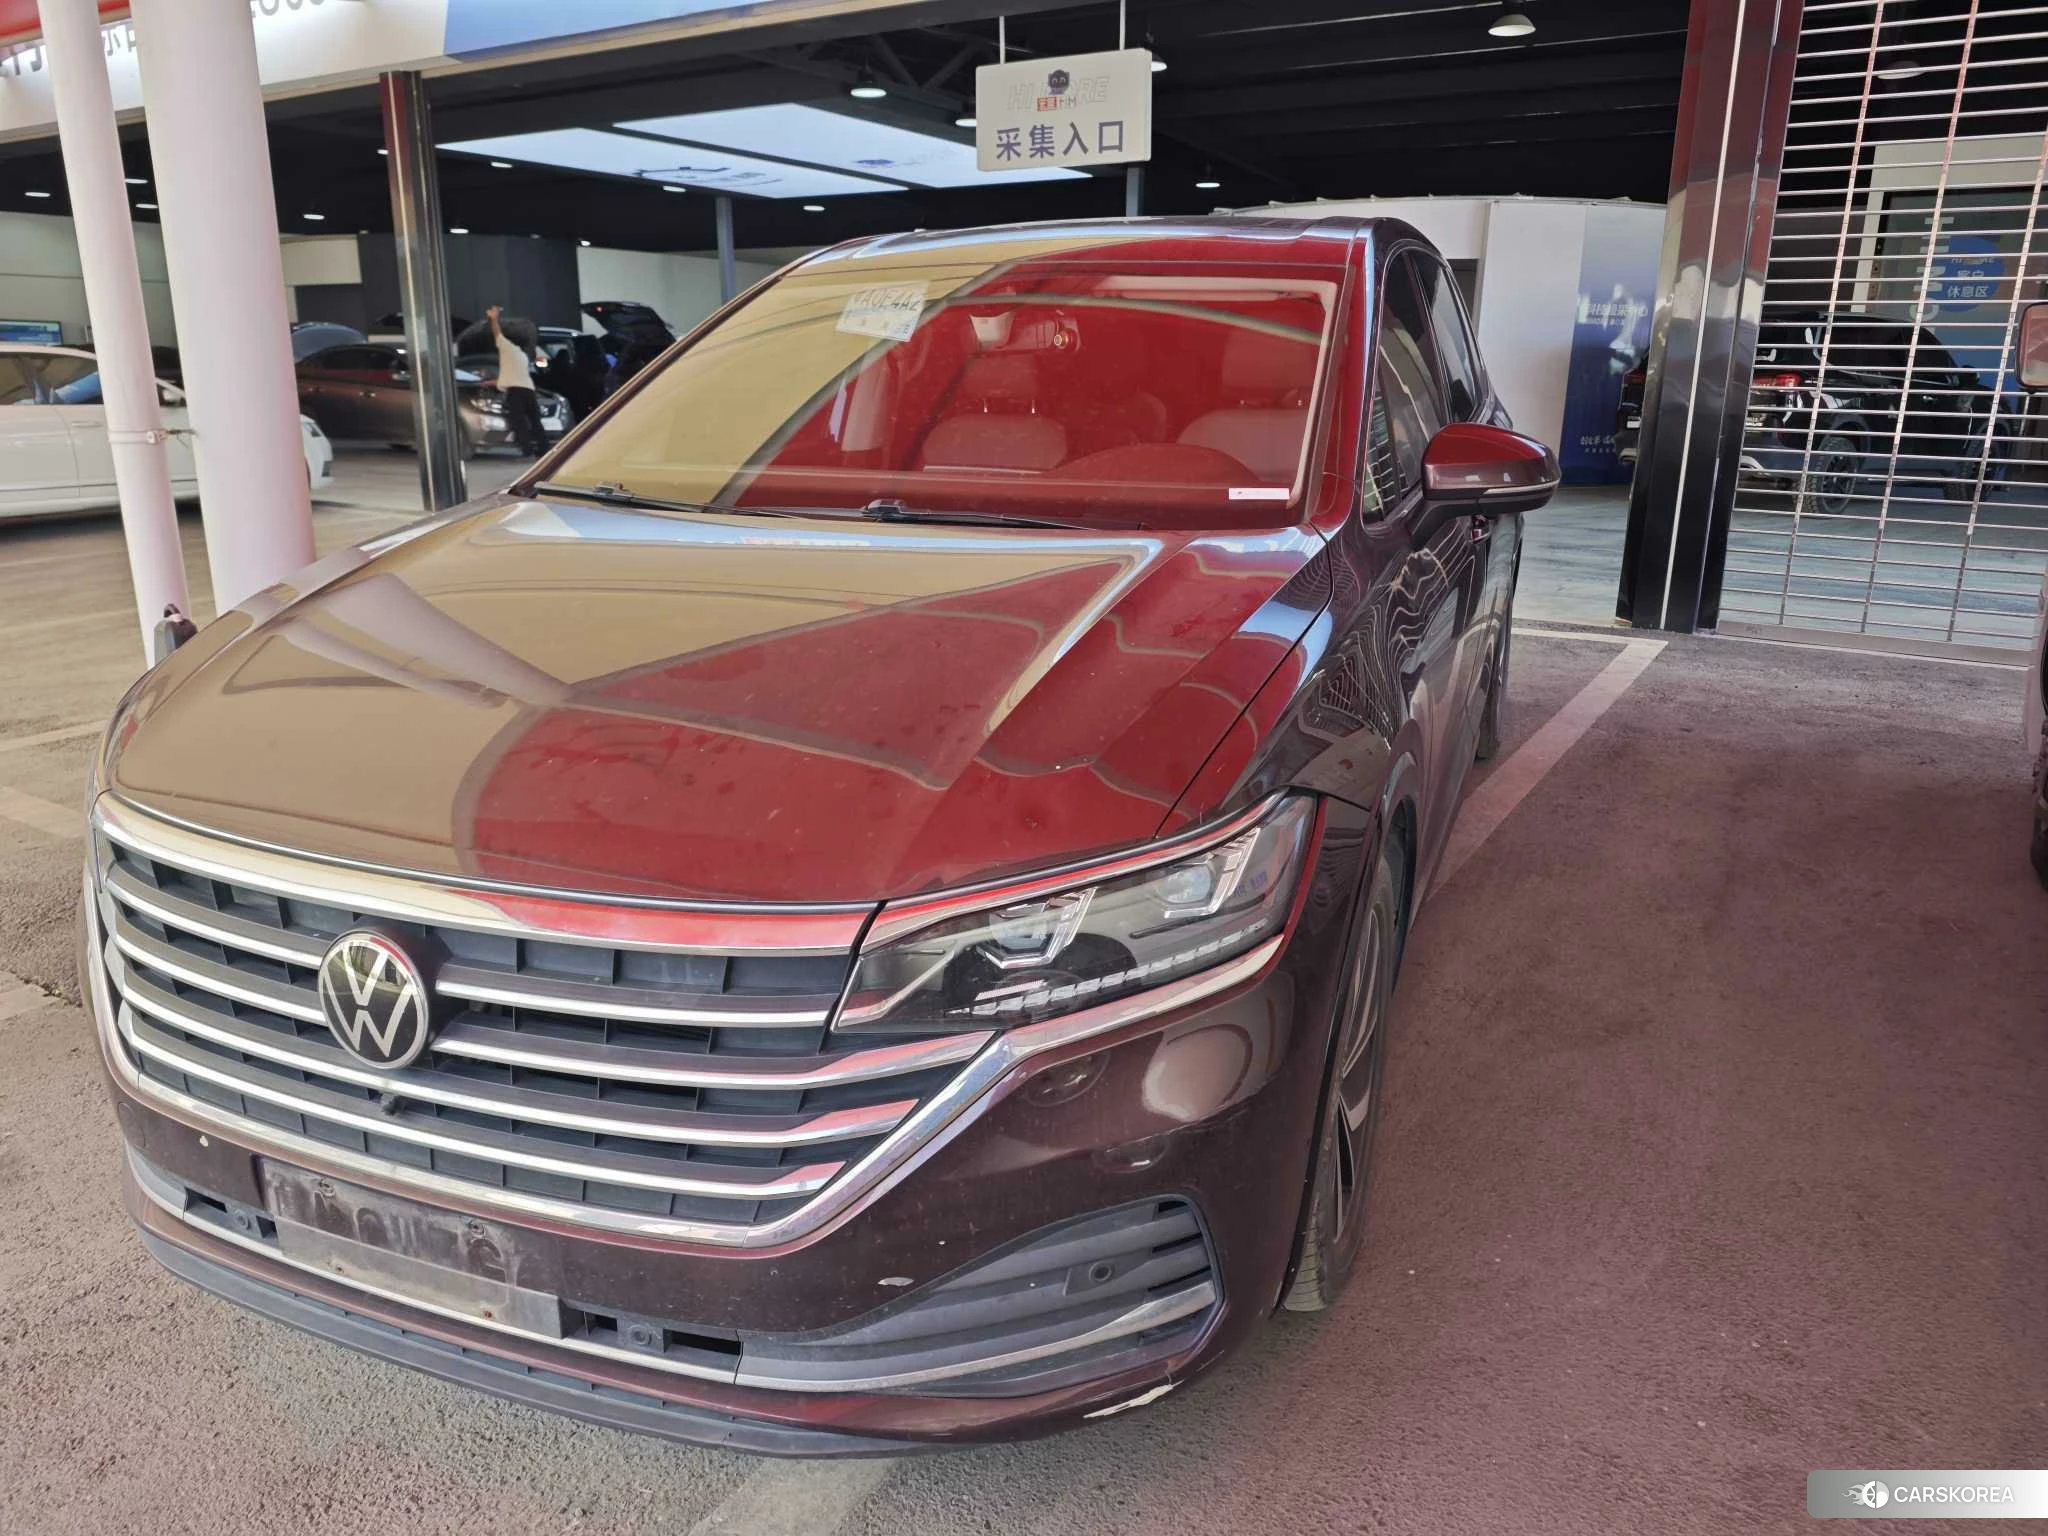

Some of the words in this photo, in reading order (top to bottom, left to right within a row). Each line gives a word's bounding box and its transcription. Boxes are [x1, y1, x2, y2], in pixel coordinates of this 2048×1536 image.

[996, 120, 1123, 161] 采集入口
[1947, 285, 1990, 298] 休息区
